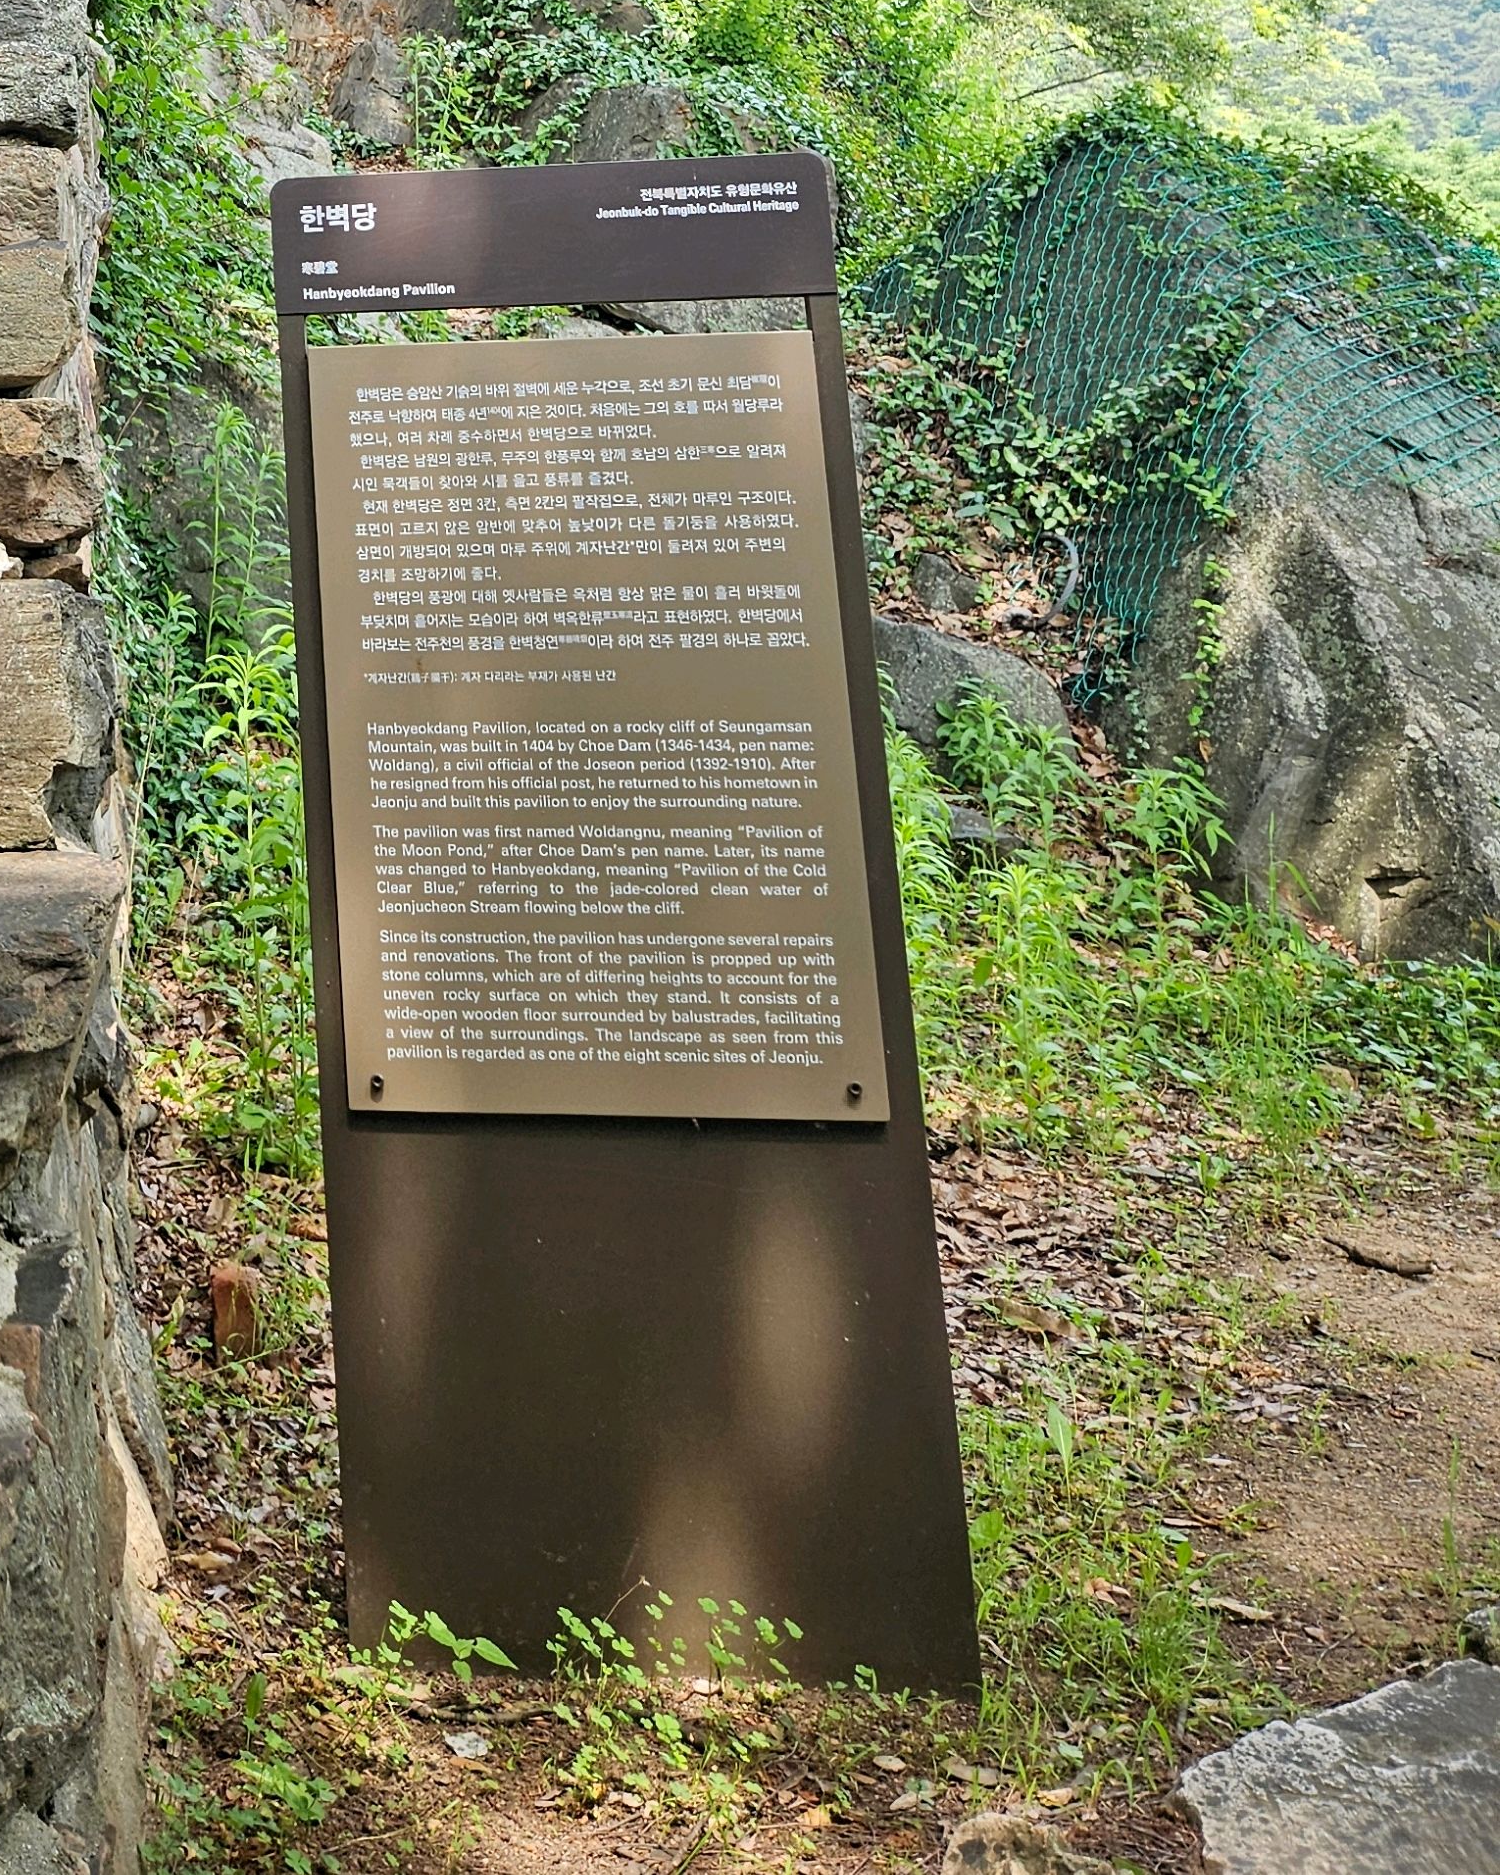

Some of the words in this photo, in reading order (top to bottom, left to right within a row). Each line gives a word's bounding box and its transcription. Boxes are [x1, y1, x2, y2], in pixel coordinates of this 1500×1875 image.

[299, 202, 377, 233] 한벽당
[596, 205, 659, 219] Jeonbuk-do
[660, 203, 707, 217] Tangible
[708, 200, 751, 213] Cultural
[752, 199, 799, 213] Heritage
[303, 286, 400, 301] Hanbyeokdang
[402, 283, 456, 296] Pavilion
[349, 431, 392, 448] 했으나,
[397, 430, 422, 446] 여러
[426, 429, 453, 445] 차례
[457, 427, 522, 444] 중수하면서
[526, 425, 594, 442] 한벽당으로
[597, 423, 656, 440] 바뀌었다.
[359, 453, 410, 469] 한벽당은
[413, 452, 451, 468] 남원의
[454, 451, 497, 468] 광한루,
[500, 450, 539, 465] 무주의
[543, 448, 596, 464] 한풍루와
[599, 447, 626, 462] 함께
[629, 446, 669, 462] 호남의
[746, 443, 786, 459] 알려져
[351, 476, 378, 492] 시인
[438, 474, 478, 490] 찾아와
[481, 473, 508, 489] 시를
[543, 471, 583, 487] 풍류를
[362, 499, 388, 514] 현재
[391, 497, 444, 514] 한벽당은
[446, 497, 472, 512] 정면
[475, 496, 500, 513] 3칸,
[504, 495, 530, 511] 측면
[533, 494, 567, 510] 2칸의
[571, 492, 642, 510] 팔작집으로,
[647, 492, 688, 508] 전체가
[692, 491, 732, 507] 마루인
[736, 489, 796, 506] 구조이다.
[354, 521, 393, 537] 표면이
[398, 521, 438, 536] 고르지
[443, 520, 470, 535] 않은
[475, 518, 516, 534] 암반에
[521, 517, 561, 534] 맞추어
[628, 515, 656, 531] 다른
[723, 512, 799, 529] 사용하였다.
[357, 567, 397, 583] 경치를
[400, 566, 466, 582] 조망하기에
[470, 565, 501, 581] 좋다.
[372, 589, 424, 606] 한벽당의
[427, 589, 467, 605] 풍광에
[471, 588, 497, 604] 대해
[572, 586, 612, 602] 옥처럼
[617, 586, 645, 602] 항상
[595, 669, 617, 681] 난간
[367, 721, 468, 738] Hanbyeokdang
[472, 720, 531, 736] Pavilion,
[535, 720, 586, 733] located
[590, 723, 608, 733] on
[612, 723, 622, 733] a
[626, 719, 665, 736] rocky
[668, 719, 696, 733] cliff
[698, 719, 715, 732] of
[718, 718, 812, 735] Seungamsan
[368, 739, 437, 755] Mountain,
[439, 742, 468, 752] was
[470, 739, 502, 752] built
[504, 739, 518, 752] in
[521, 739, 554, 752] 1404
[557, 738, 575, 754] by
[577, 738, 615, 752] Choe
[617, 738, 651, 752] Dam
[654, 737, 735, 753] (1346-1434,
[738, 741, 766, 754] pen
[769, 741, 814, 751] name:
[367, 757, 439, 774] Woldang),
[443, 761, 451, 771] a
[455, 758, 483, 771] civil
[487, 757, 534, 771] official
[537, 757, 553, 771] of
[555, 757, 579, 770] the
[582, 757, 635, 770] Joseon
[639, 756, 685, 773] period
[689, 756, 776, 772] (1392-1910).
[779, 756, 817, 770] After
[371, 824, 399, 838] The
[403, 824, 458, 840] pavilion
[461, 827, 490, 838] was
[493, 824, 522, 838] first
[526, 824, 575, 838] named
[577, 824, 665, 841] Woldangnu,
[669, 824, 733, 841] meaning
[806, 825, 824, 839] of
[374, 865, 403, 875] was
[407, 861, 467, 878] changed
[471, 863, 486, 875] to
[491, 862, 600, 879] Hanbyeokdang,
[605, 862, 668, 879] meaning
[743, 862, 760, 877] of
[763, 863, 788, 877] the
[792, 863, 827, 877] Cold
[376, 880, 413, 894] Clear
[477, 880, 538, 897] referring
[549, 882, 564, 894] to
[574, 881, 599, 894] the
[609, 881, 699, 898] jade-colored
[709, 882, 749, 896] clean
[759, 884, 802, 896] water
[812, 882, 830, 896] of
[377, 899, 466, 916] Jeonjucheon
[469, 899, 520, 913] Stream
[523, 899, 577, 916] flowing
[580, 900, 624, 914] below
[626, 900, 651, 914] the
[653, 900, 684, 914] cliff.
[379, 929, 418, 943] Since
[420, 929, 437, 943] its
[439, 929, 530, 945] construction,
[532, 930, 556, 944] the
[558, 930, 615, 947] pavilion
[617, 931, 644, 944] has
[646, 931, 725, 949] undergone
[726, 932, 779, 946] several
[782, 932, 834, 949] repairs
